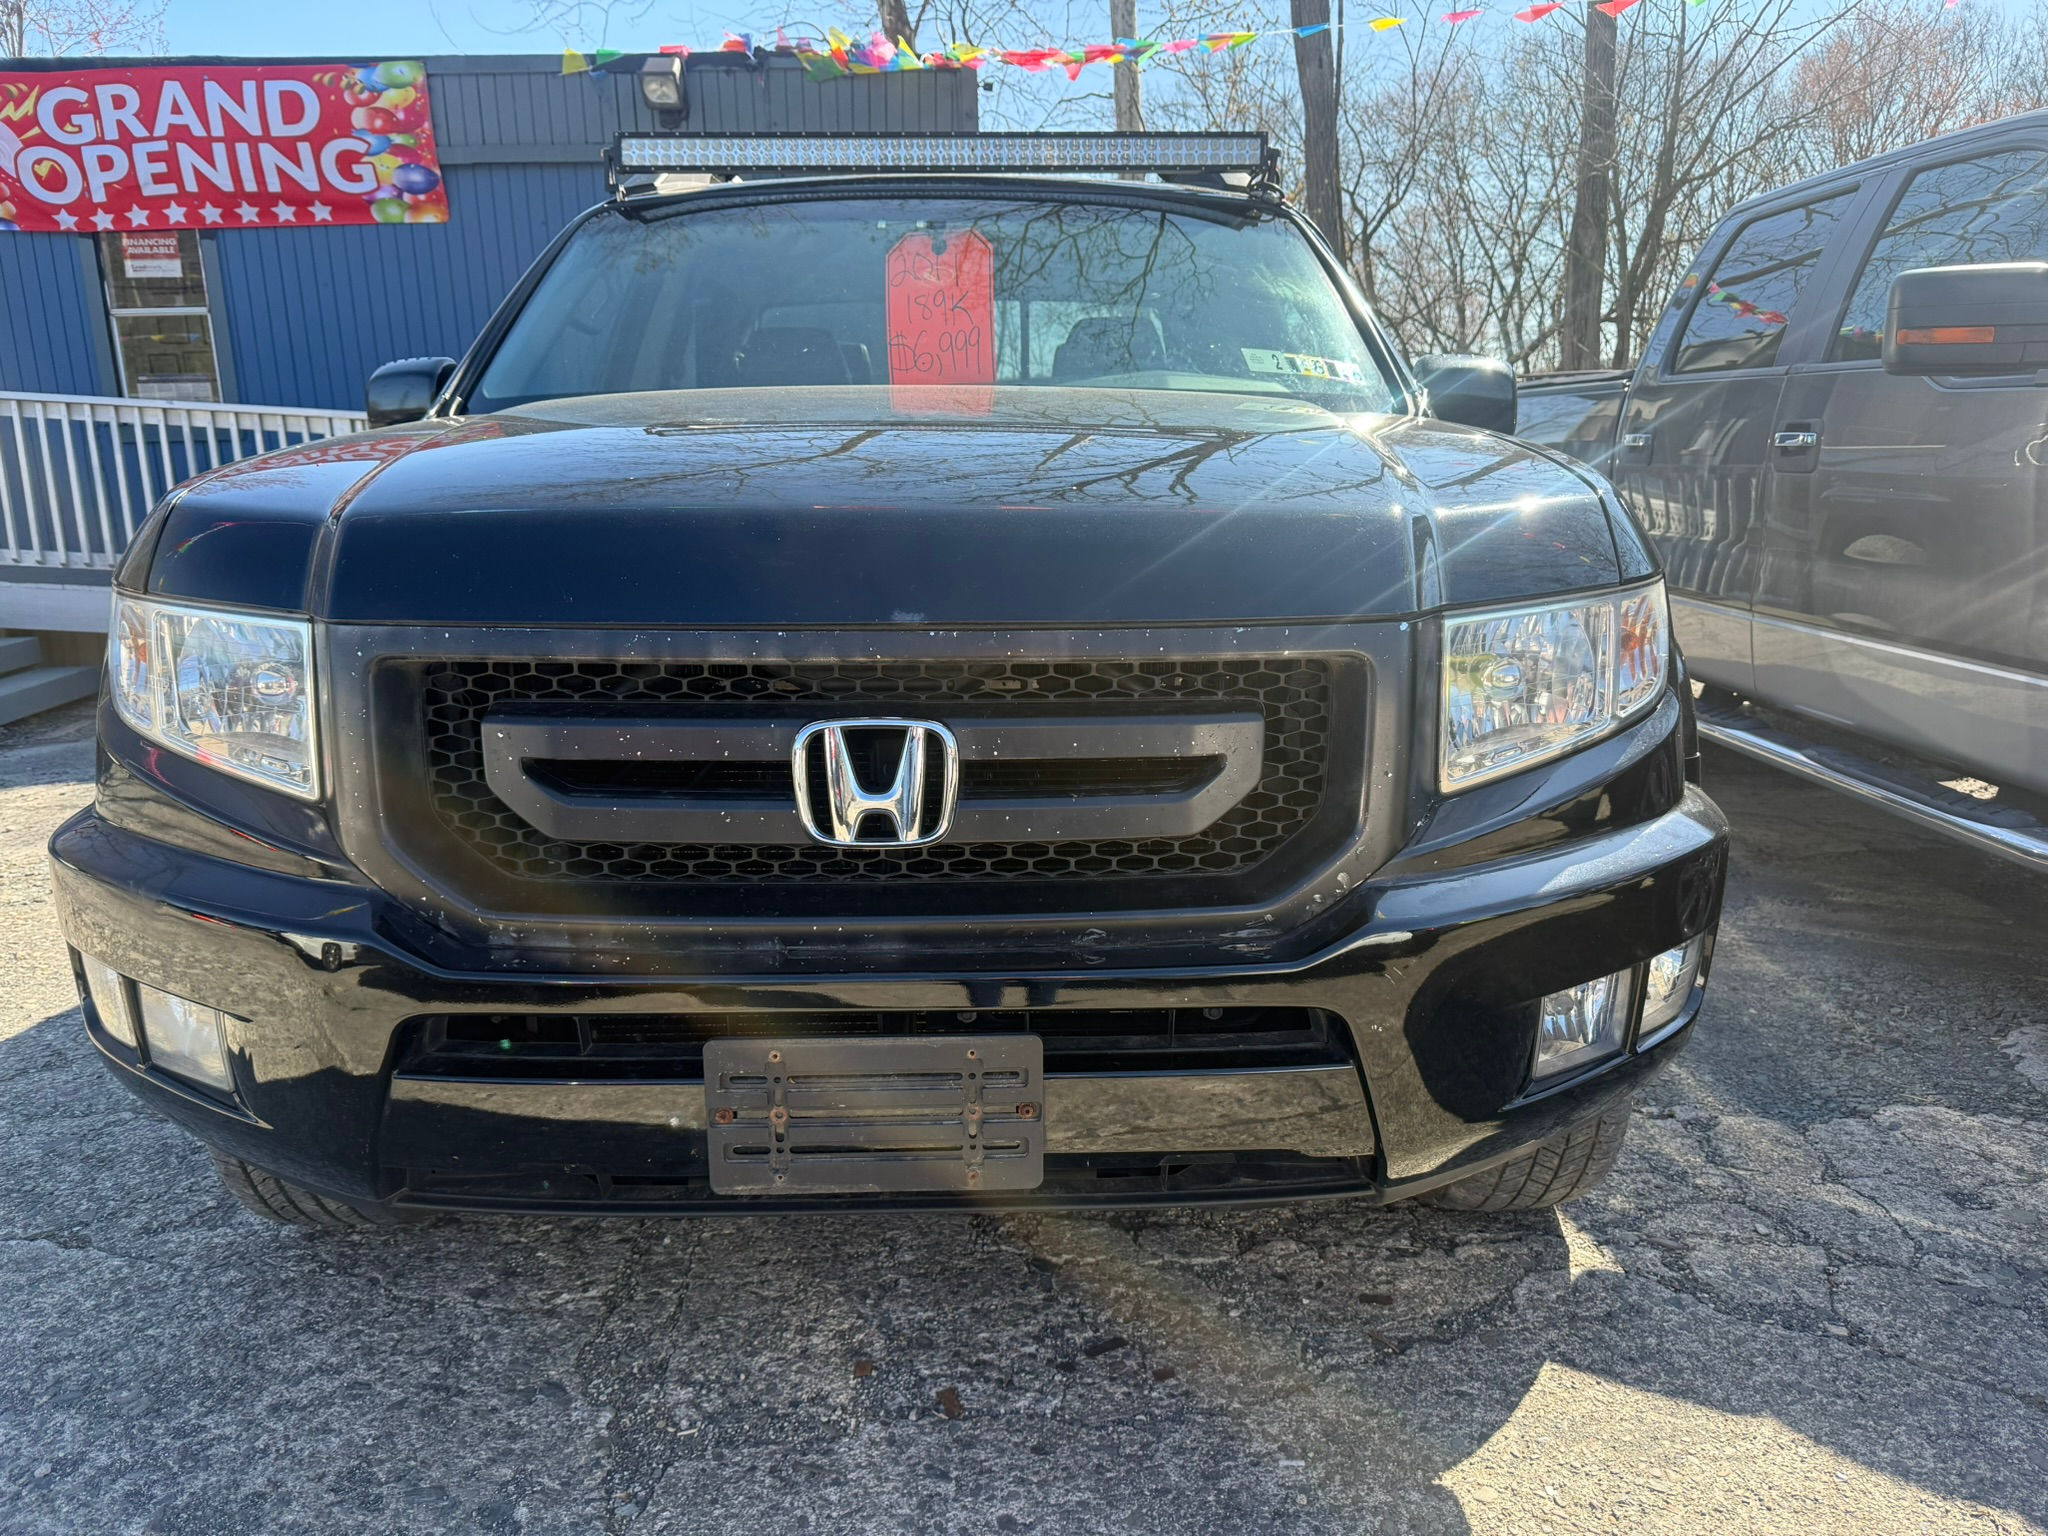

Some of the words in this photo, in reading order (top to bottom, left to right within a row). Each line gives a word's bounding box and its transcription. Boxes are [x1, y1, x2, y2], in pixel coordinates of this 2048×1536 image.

[36, 79, 321, 146] GRAND
[16, 138, 379, 205] OPENING
[128, 246, 176, 254] AVAILABLE
[907, 289, 974, 326] 189K
[889, 326, 981, 377] $6,999
